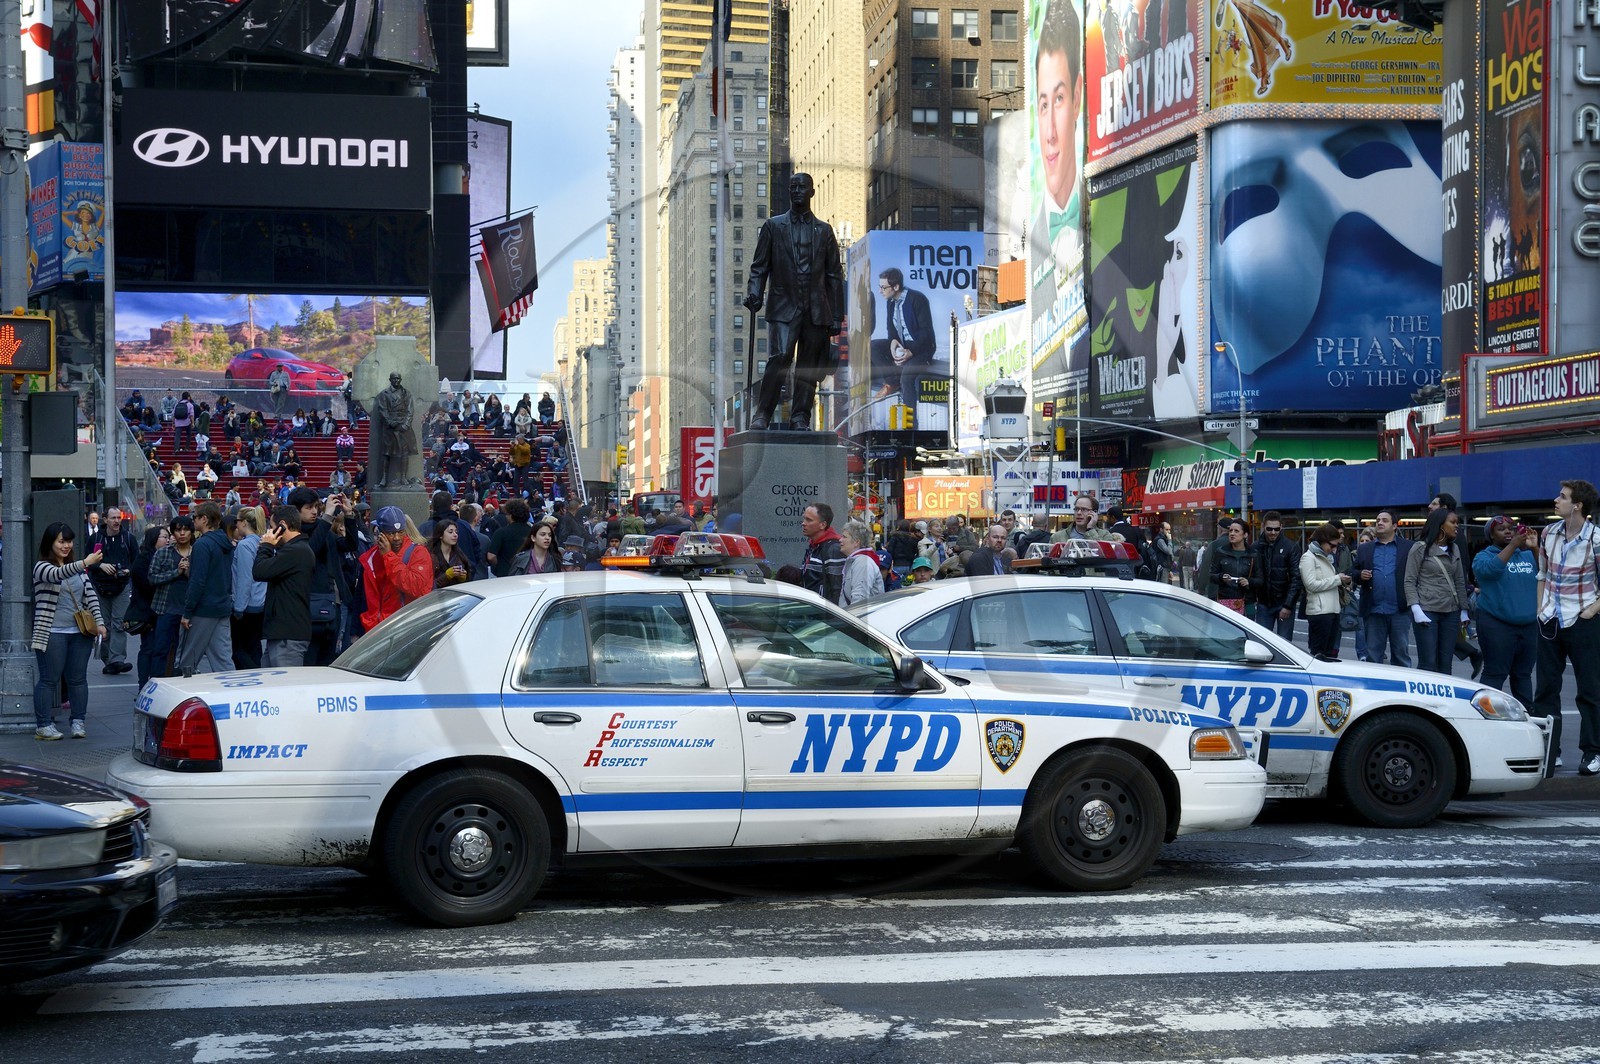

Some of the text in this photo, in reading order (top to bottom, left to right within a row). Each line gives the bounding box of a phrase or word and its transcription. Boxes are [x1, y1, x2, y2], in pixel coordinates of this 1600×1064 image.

[1325, 30, 1336, 45] A
[1342, 29, 1367, 45] New
[1372, 29, 1419, 45] Musical
[1351, 61, 1379, 70] GEORGE
[1381, 61, 1418, 70] GERSHWIN
[1428, 61, 1440, 70] IRA
[1097, 32, 1195, 139] JERSEY BOYS
[1312, 74, 1325, 83] JOE
[1327, 74, 1360, 83] DIPIETRO
[1381, 74, 1395, 83] GUY
[1398, 74, 1426, 83] BOLTON
[1390, 86, 1426, 95] KATHLEEN
[72, 153, 95, 161] BEST
[222, 135, 408, 168] HYUNDAI
[63, 162, 104, 171] MUSICAL
[1151, 152, 1174, 170] DOROTHY
[63, 171, 104, 179] REVIVAL
[909, 245, 972, 266] men
[910, 268, 924, 280] at
[1488, 287, 1494, 300] 5
[1496, 282, 1513, 296] TONY
[1488, 295, 1522, 322] BEST
[1385, 315, 1430, 333] THE
[1488, 333, 1512, 347] LINCOLN
[1512, 329, 1533, 342] CENTER
[1516, 342, 1532, 351] SUBWAY
[1533, 340, 1539, 348] TO
[1314, 336, 1442, 367] PHANT
[1097, 353, 1146, 395] WICKED
[1327, 369, 1356, 388] OF
[1362, 368, 1408, 387] THE
[1497, 360, 1600, 407] OUTRAGEOUS FUN!
[1211, 421, 1224, 429] city
[876, 450, 895, 459] Wagner
[1150, 460, 1184, 494] sbarro
[1187, 454, 1225, 491] sbarro
[771, 485, 819, 496] GEORGE
[934, 480, 970, 489] Playland
[925, 491, 979, 509] GIFTS
[1408, 681, 1455, 698] POLICE
[317, 695, 358, 713] PBMS
[1180, 685, 1308, 728] NYPD
[1131, 706, 1190, 727] POLICE
[987, 726, 1022, 737] DEPARTMENT
[227, 744, 308, 759] IMPACT
[789, 713, 962, 774] NYPD
